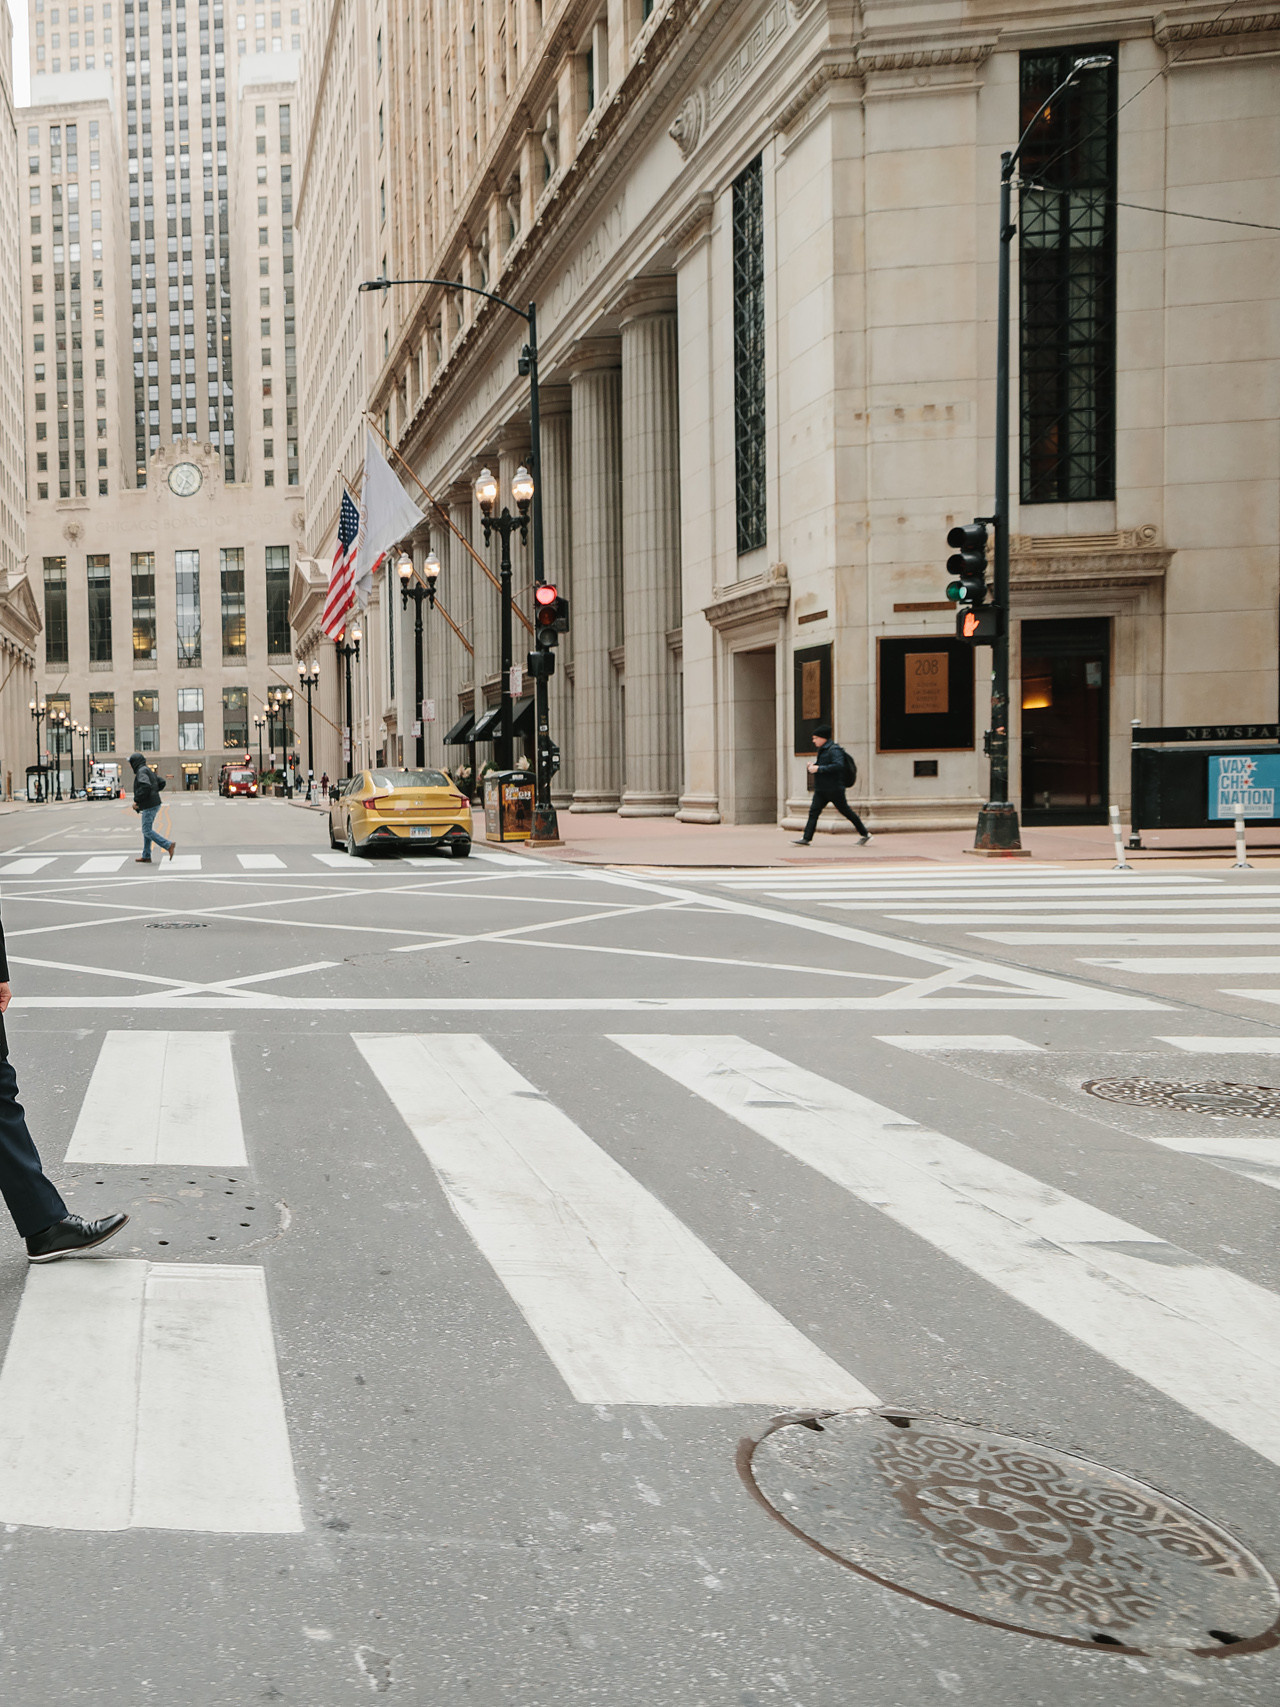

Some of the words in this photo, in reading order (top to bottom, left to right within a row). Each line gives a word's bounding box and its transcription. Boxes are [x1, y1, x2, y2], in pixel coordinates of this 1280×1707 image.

[95, 519, 159, 534] CHICAGO
[163, 515, 209, 530] BOARD
[215, 514, 232, 527] OF
[914, 660, 939, 676] 208
[1221, 759, 1249, 774] VAX
[1220, 790, 1273, 805] NATION
